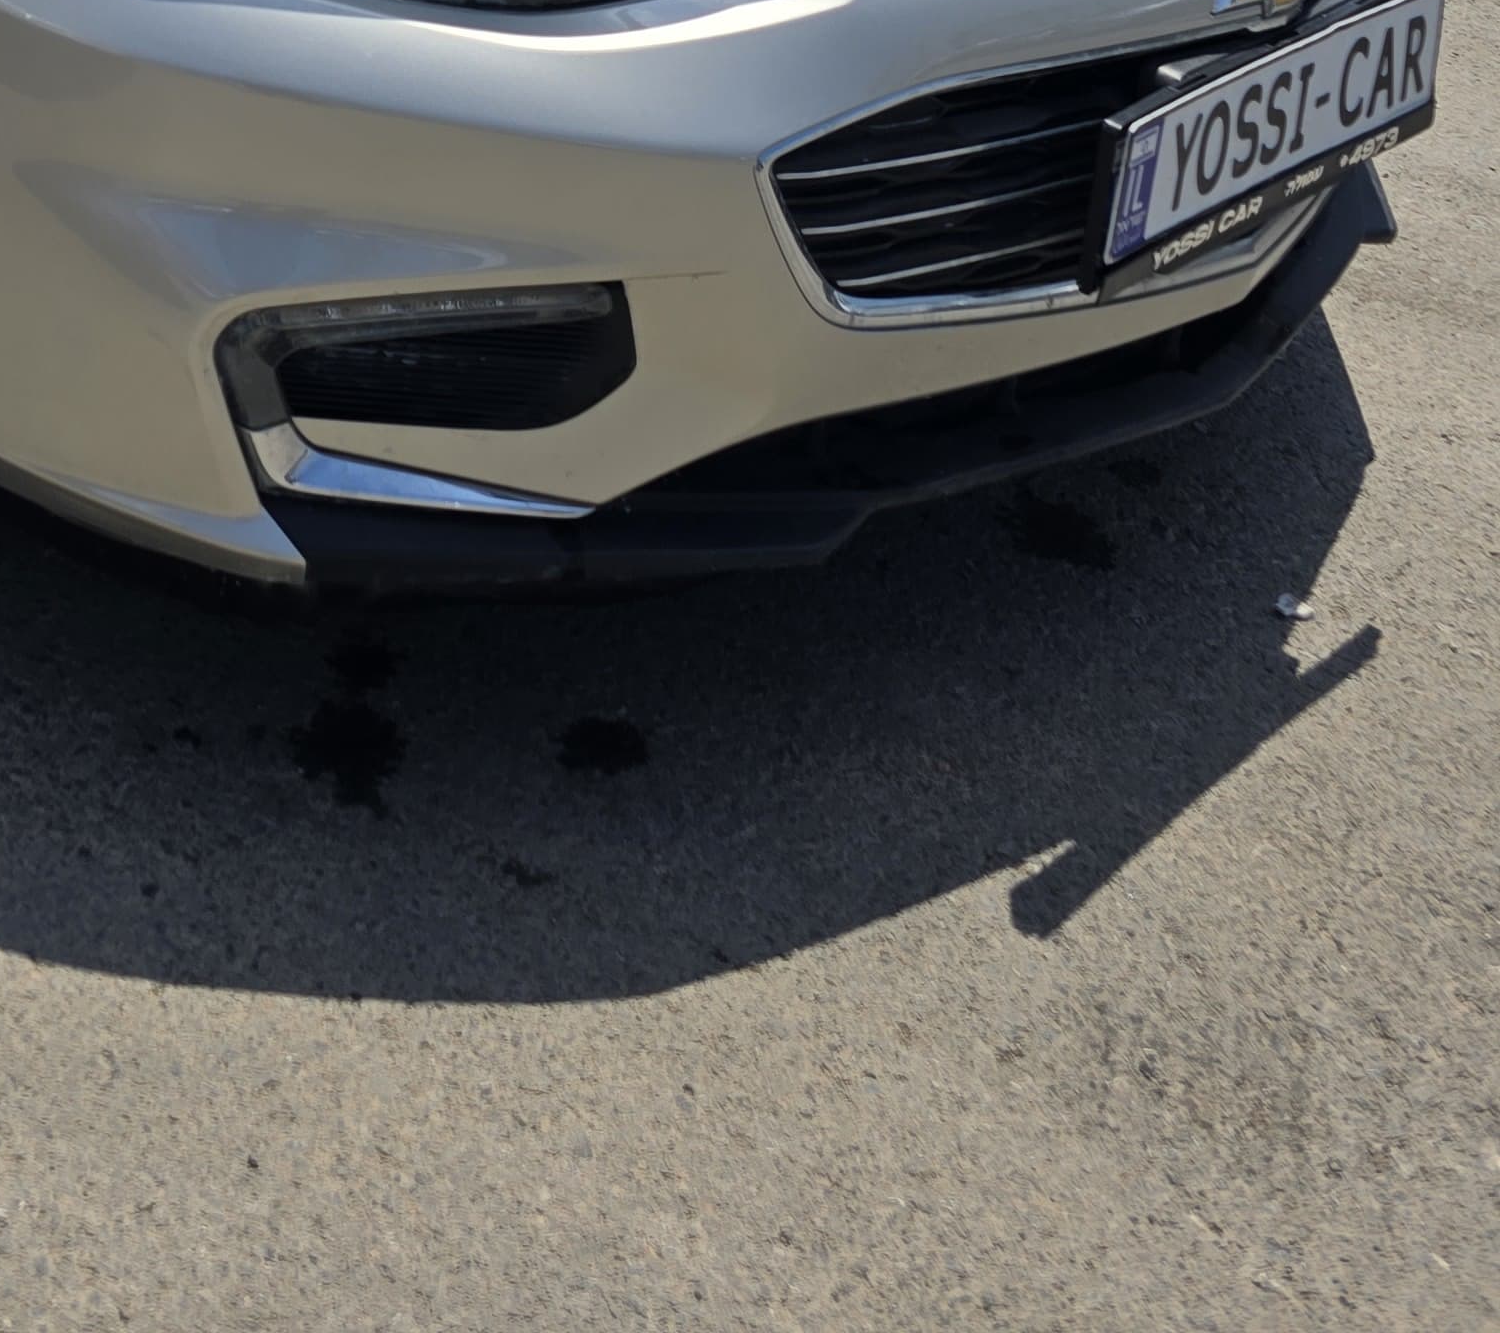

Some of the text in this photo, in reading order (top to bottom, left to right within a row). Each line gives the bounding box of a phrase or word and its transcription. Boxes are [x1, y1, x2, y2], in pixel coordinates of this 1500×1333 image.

[1170, 14, 1428, 213] YOSSI-CAR
[1153, 217, 1215, 271] YOSSI
[1218, 196, 1263, 233] CAR
